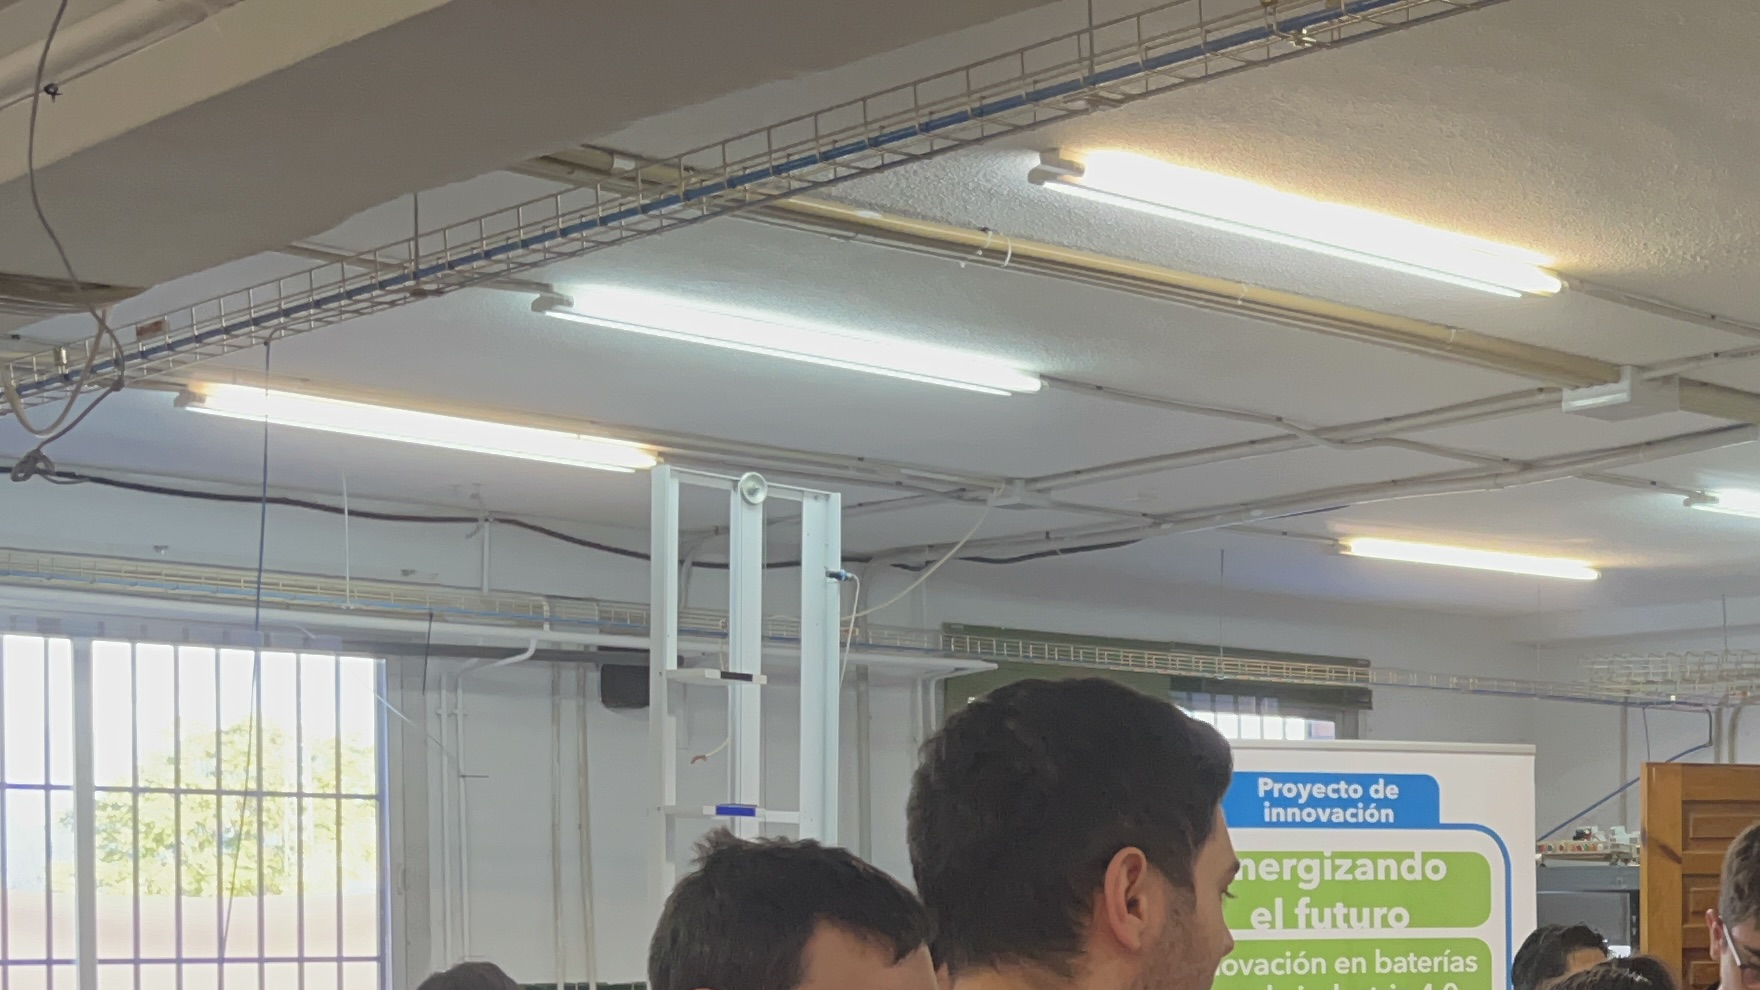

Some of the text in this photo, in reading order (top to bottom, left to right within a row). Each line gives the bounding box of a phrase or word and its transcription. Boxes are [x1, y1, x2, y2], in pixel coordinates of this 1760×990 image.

[1258, 777, 1400, 803] Proyecto de
[1263, 802, 1395, 824] innovación
[1235, 850, 1447, 890] nergizando
[1251, 897, 1411, 929] el futuro
[1215, 950, 1478, 977] ovación en baterías
